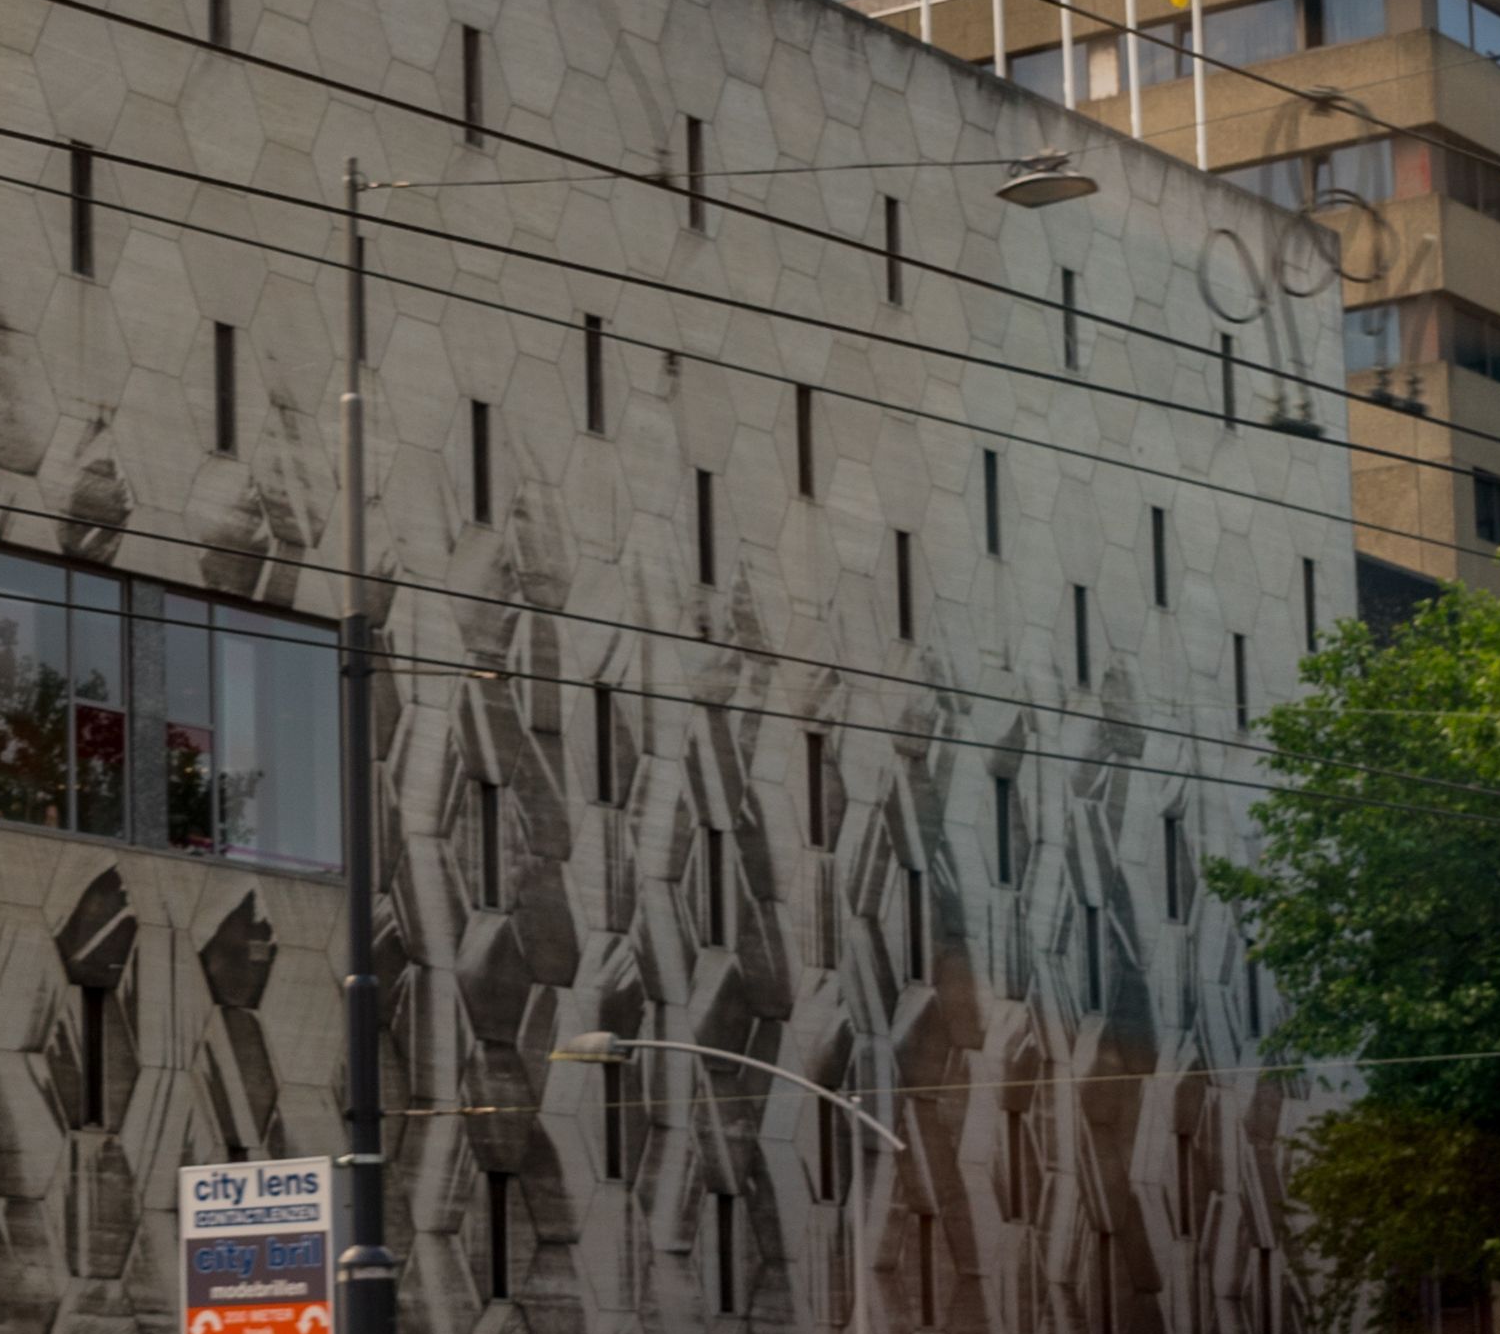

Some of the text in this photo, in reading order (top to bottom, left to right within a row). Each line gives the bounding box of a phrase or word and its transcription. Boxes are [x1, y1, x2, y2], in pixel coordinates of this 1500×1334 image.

[195, 1168, 319, 1205] city lens
[195, 1235, 322, 1278] city bril
